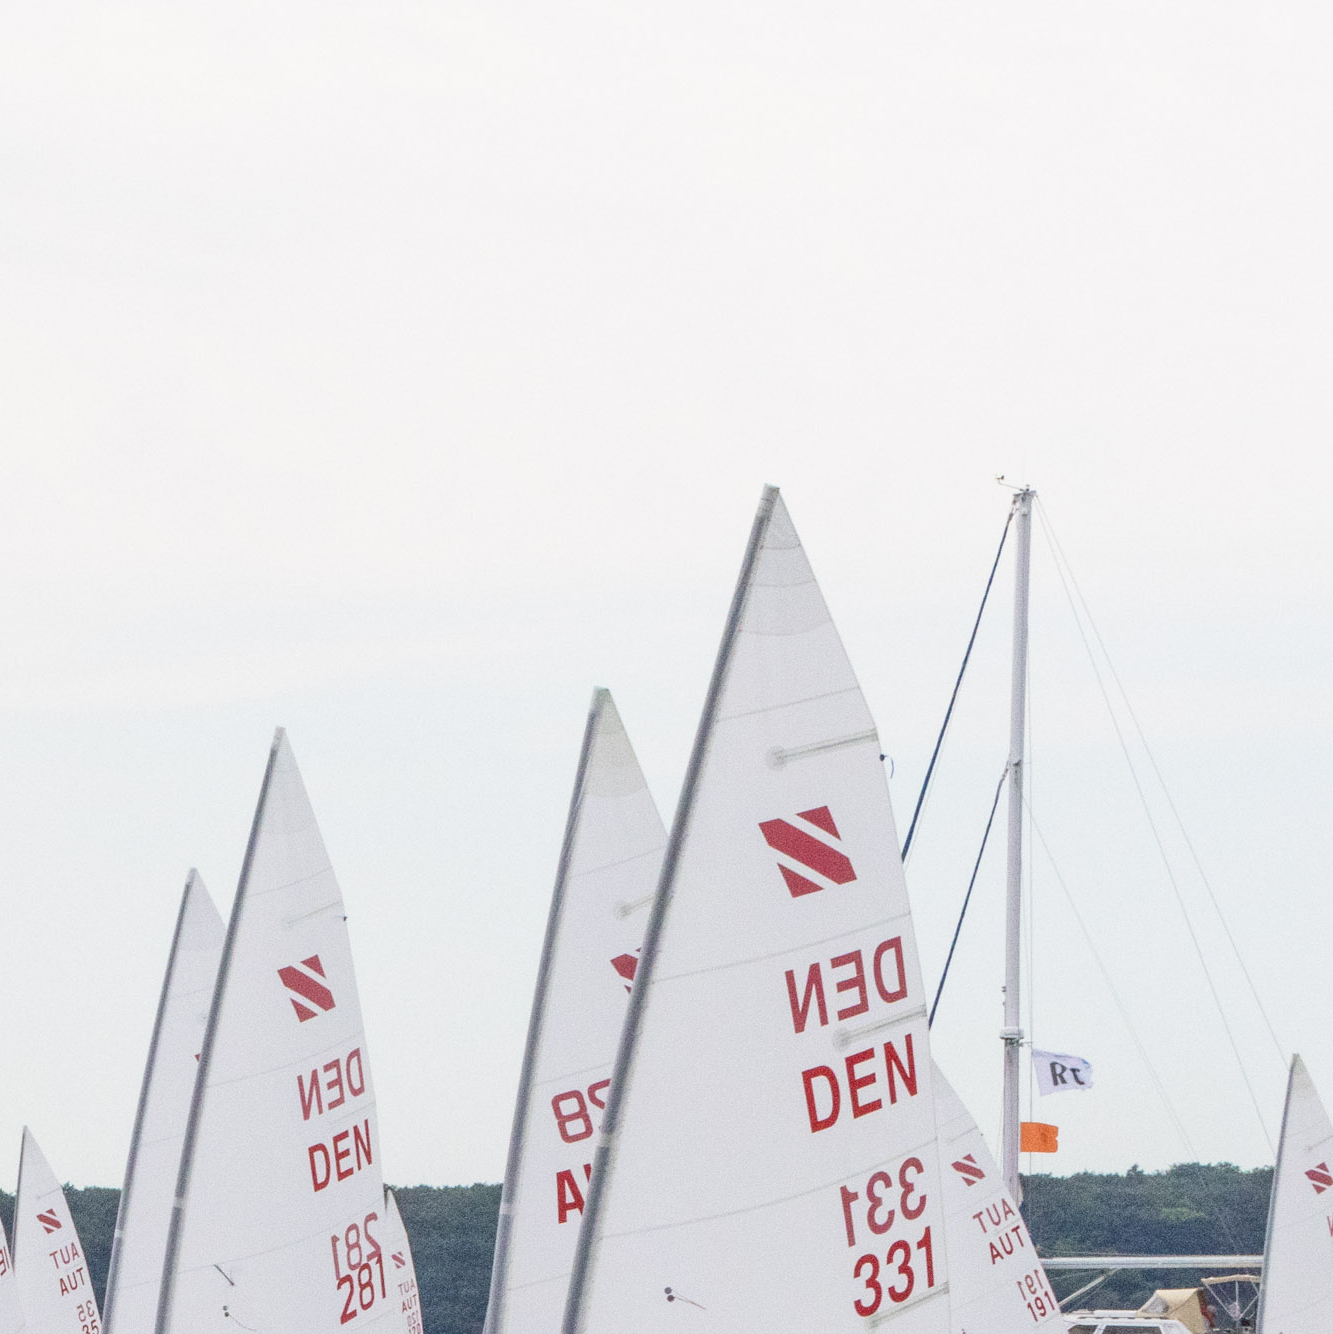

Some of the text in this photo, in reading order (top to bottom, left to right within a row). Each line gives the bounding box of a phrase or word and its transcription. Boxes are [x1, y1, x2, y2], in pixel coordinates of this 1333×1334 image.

[801, 1034, 919, 1134] DEN
[308, 1119, 372, 1192] DEN
[853, 1226, 935, 1318] 331
[989, 1225, 1024, 1265] AUT
[60, 1267, 85, 1296] AUT
[337, 1252, 386, 1325] 281
[402, 1294, 417, 1313] AUT
[1027, 1291, 1055, 1322] 191
